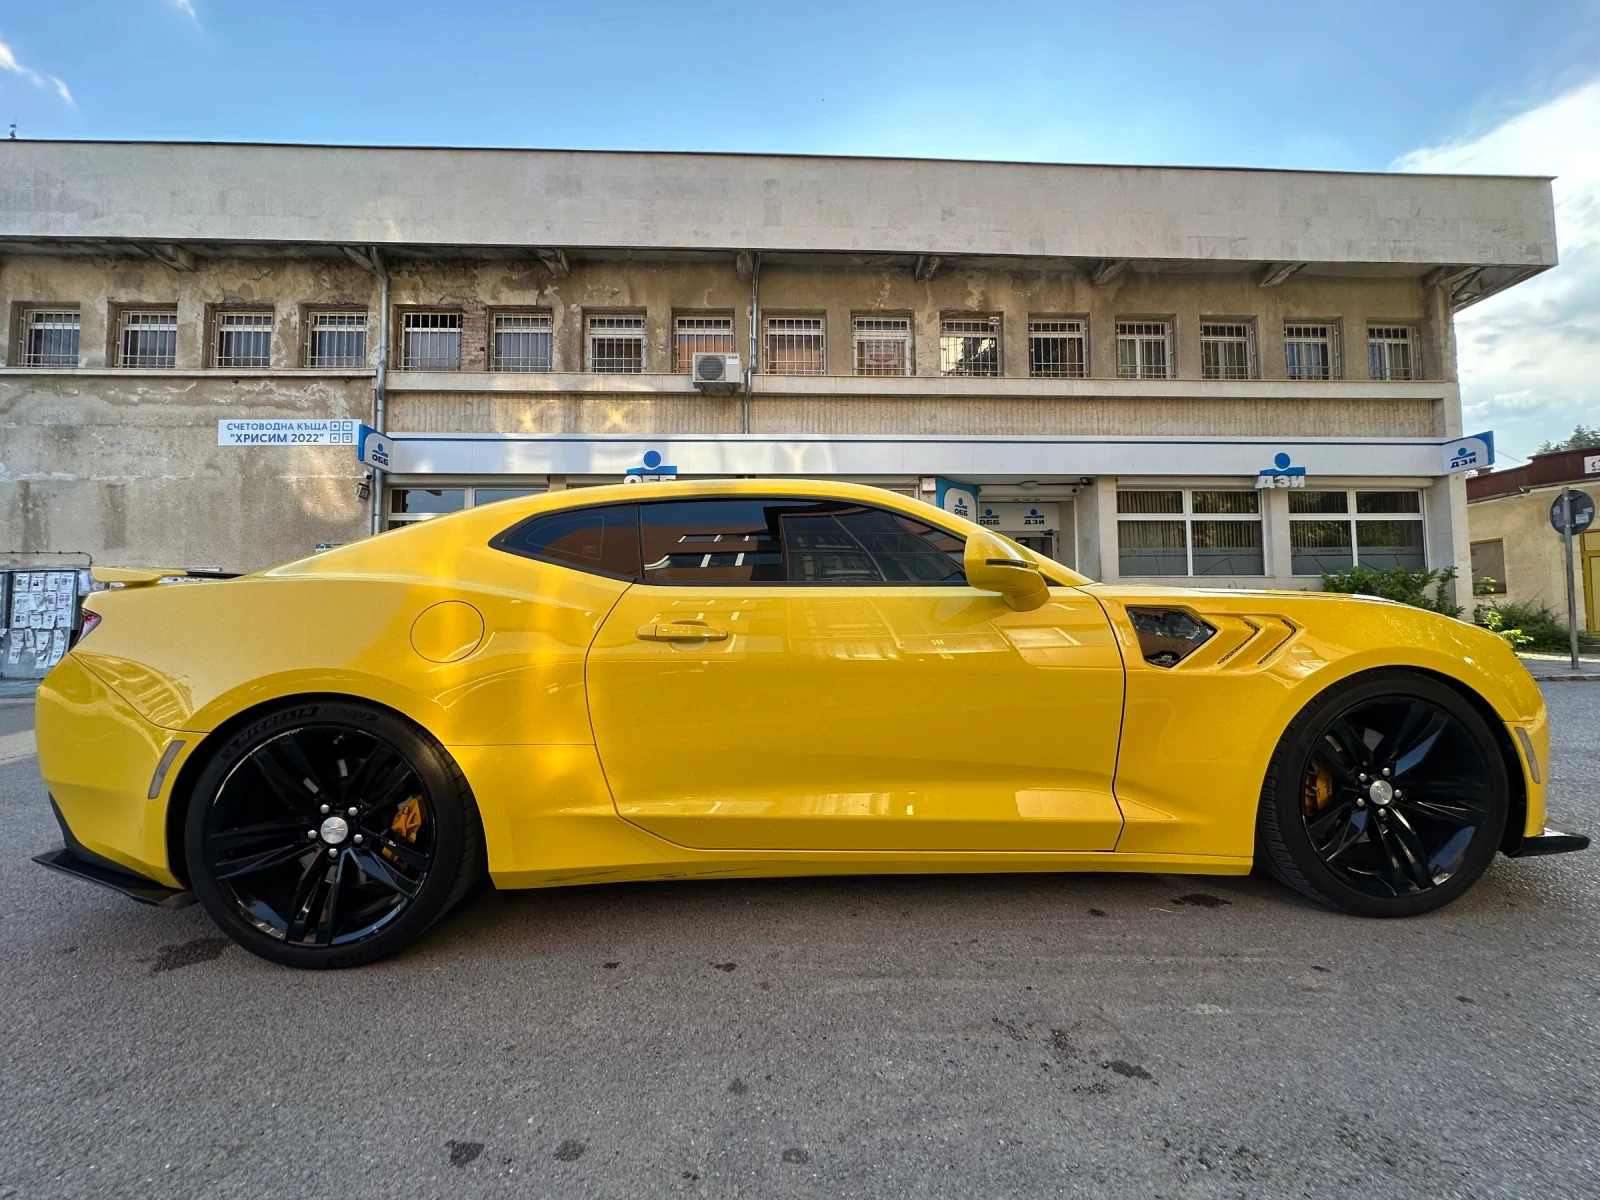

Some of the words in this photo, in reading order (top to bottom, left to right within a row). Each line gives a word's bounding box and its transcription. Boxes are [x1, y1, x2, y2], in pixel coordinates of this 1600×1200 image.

[226, 422, 294, 431] СЧЕТОВОДНА
[297, 422, 328, 431] КЪЩА
[230, 433, 287, 443] "ХРИСИМ
[291, 433, 324, 443] 2022"
[372, 453, 389, 466] ОББ
[1450, 456, 1477, 469] ДЗИ
[1254, 475, 1305, 489] ДЗИ
[954, 508, 968, 517] ОББ
[237, 706, 317, 746] MICHELIN
